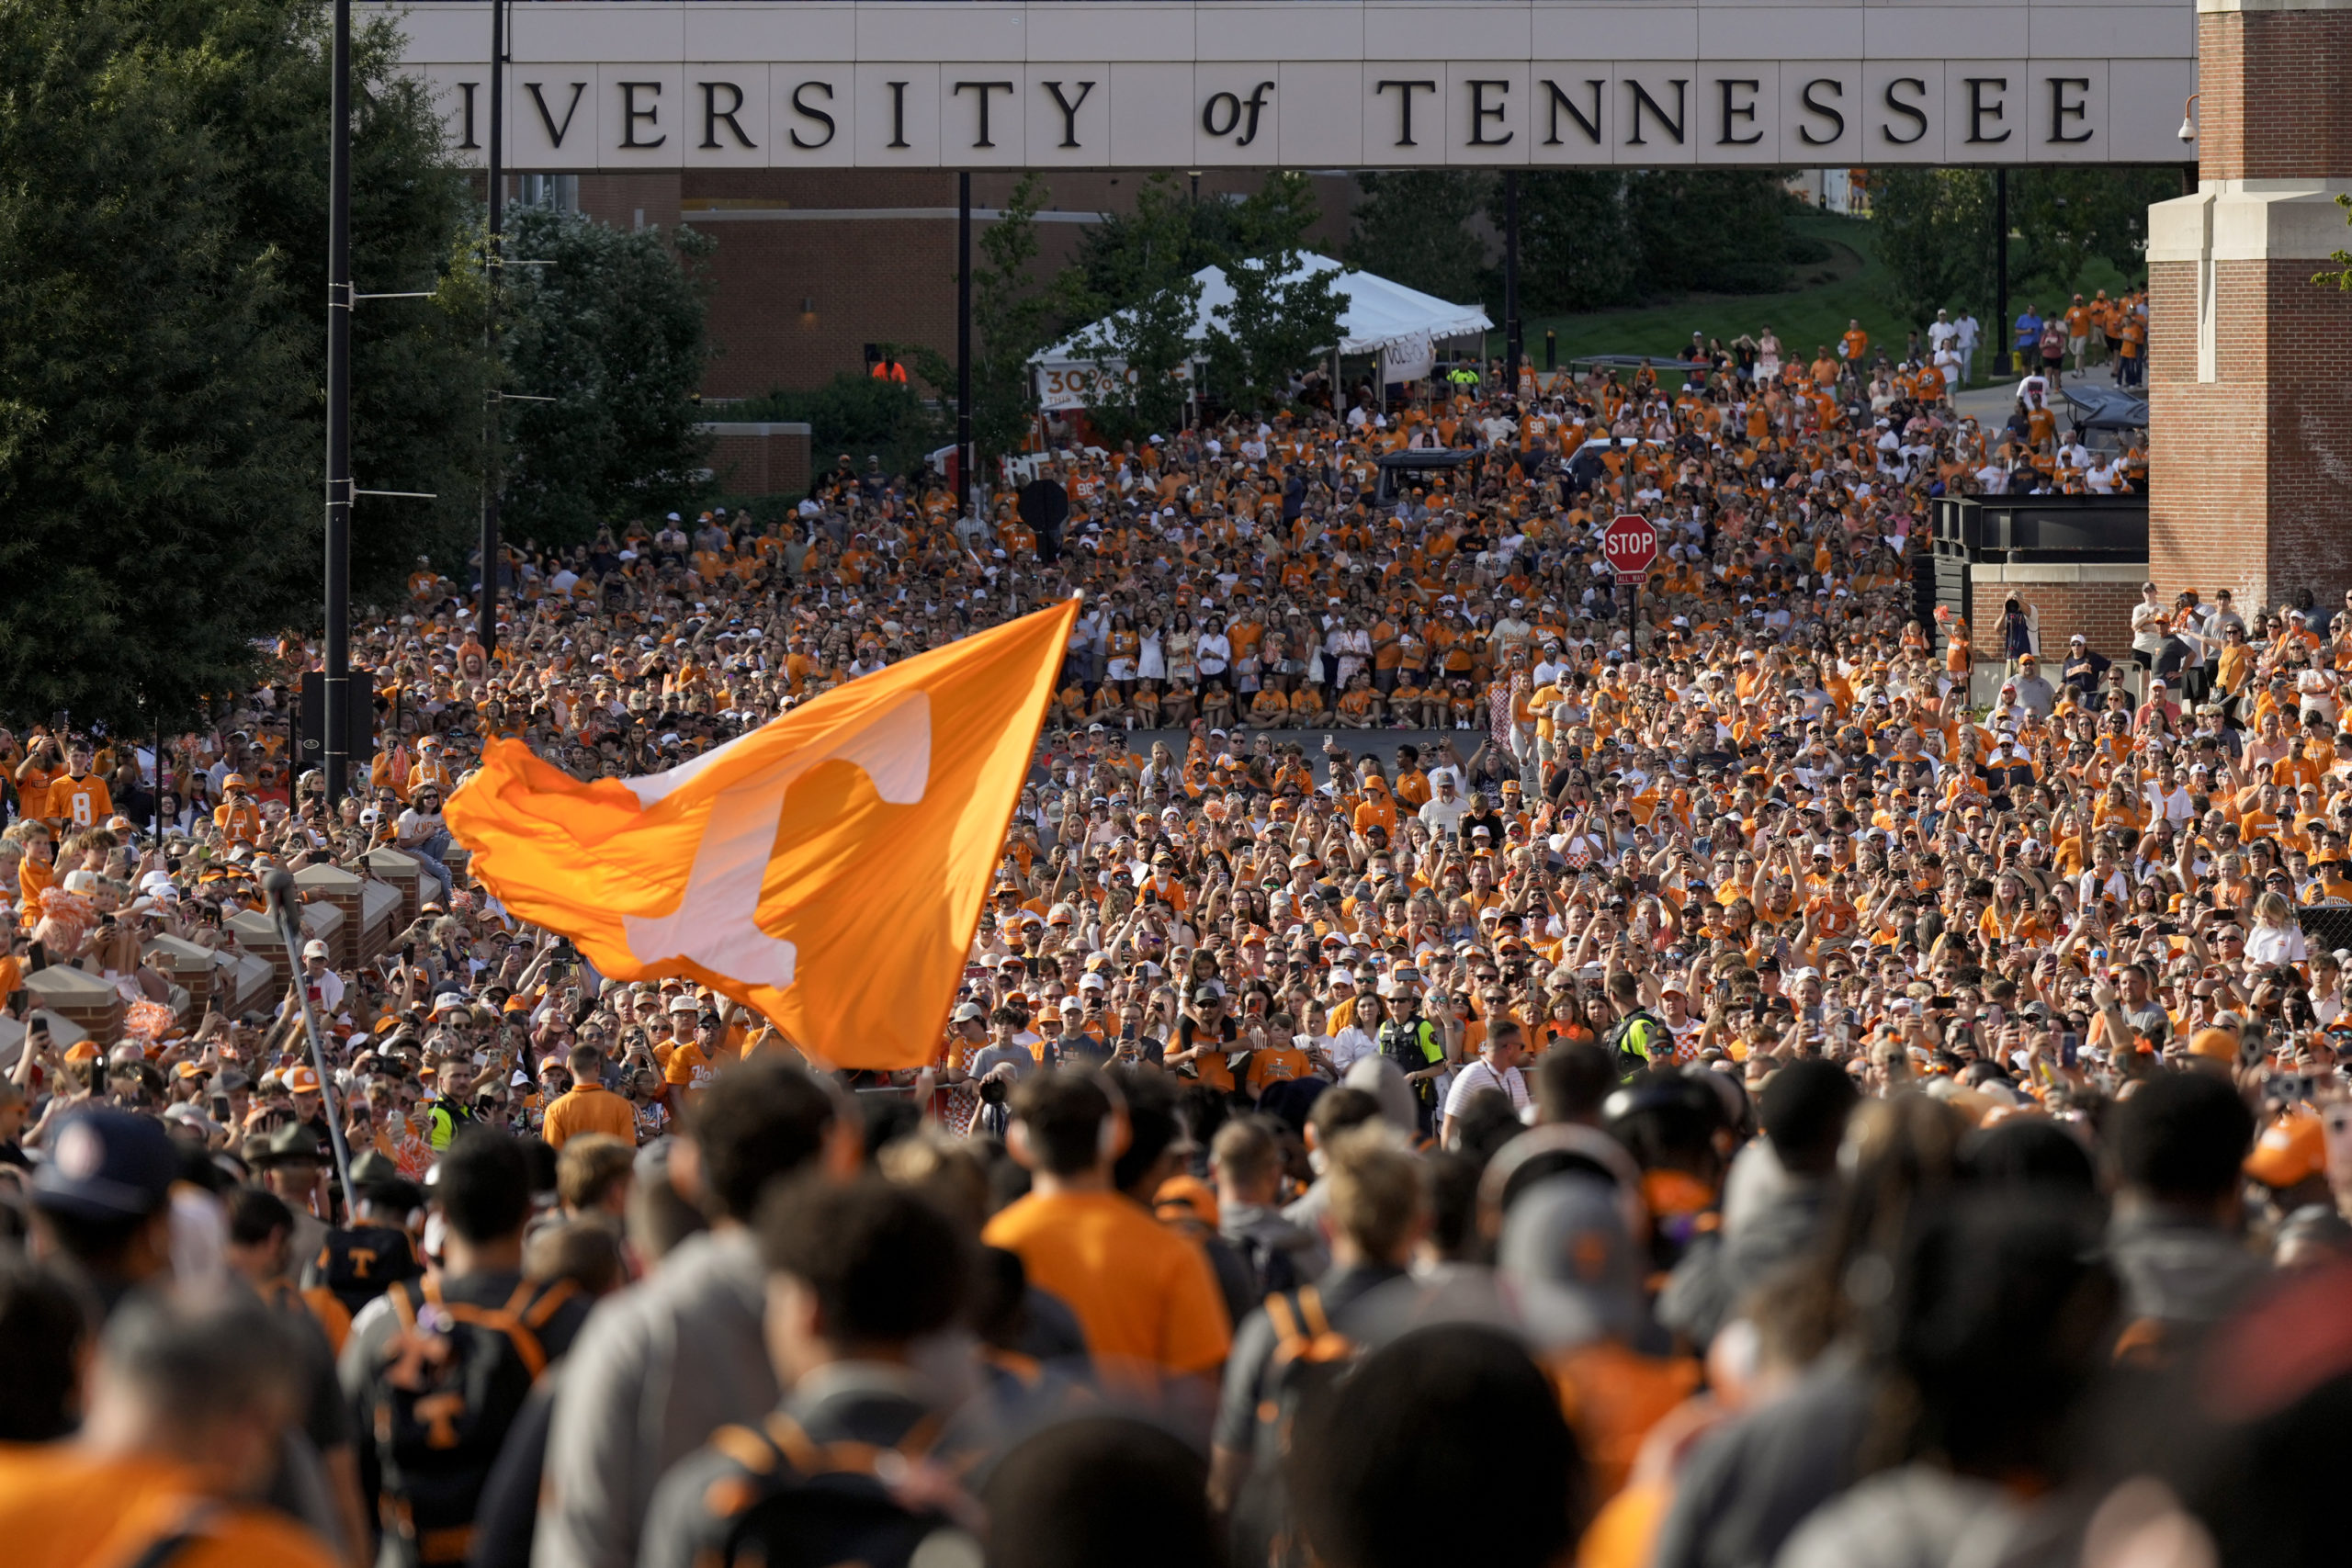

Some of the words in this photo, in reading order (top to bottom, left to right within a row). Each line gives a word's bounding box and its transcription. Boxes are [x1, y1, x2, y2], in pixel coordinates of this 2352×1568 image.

[356, 79, 1096, 150] IVERSITY
[1202, 80, 1275, 147] of
[1376, 77, 2094, 146] TENNESSEE
[1046, 369, 1114, 395] 30%
[1608, 532, 1654, 556] STOP
[1617, 575, 1629, 583] ALL
[1632, 574, 1645, 582] WAY
[72, 792, 91, 827] 8
[621, 689, 932, 991] T
[348, 1247, 378, 1279] T
[413, 1393, 467, 1450] T
